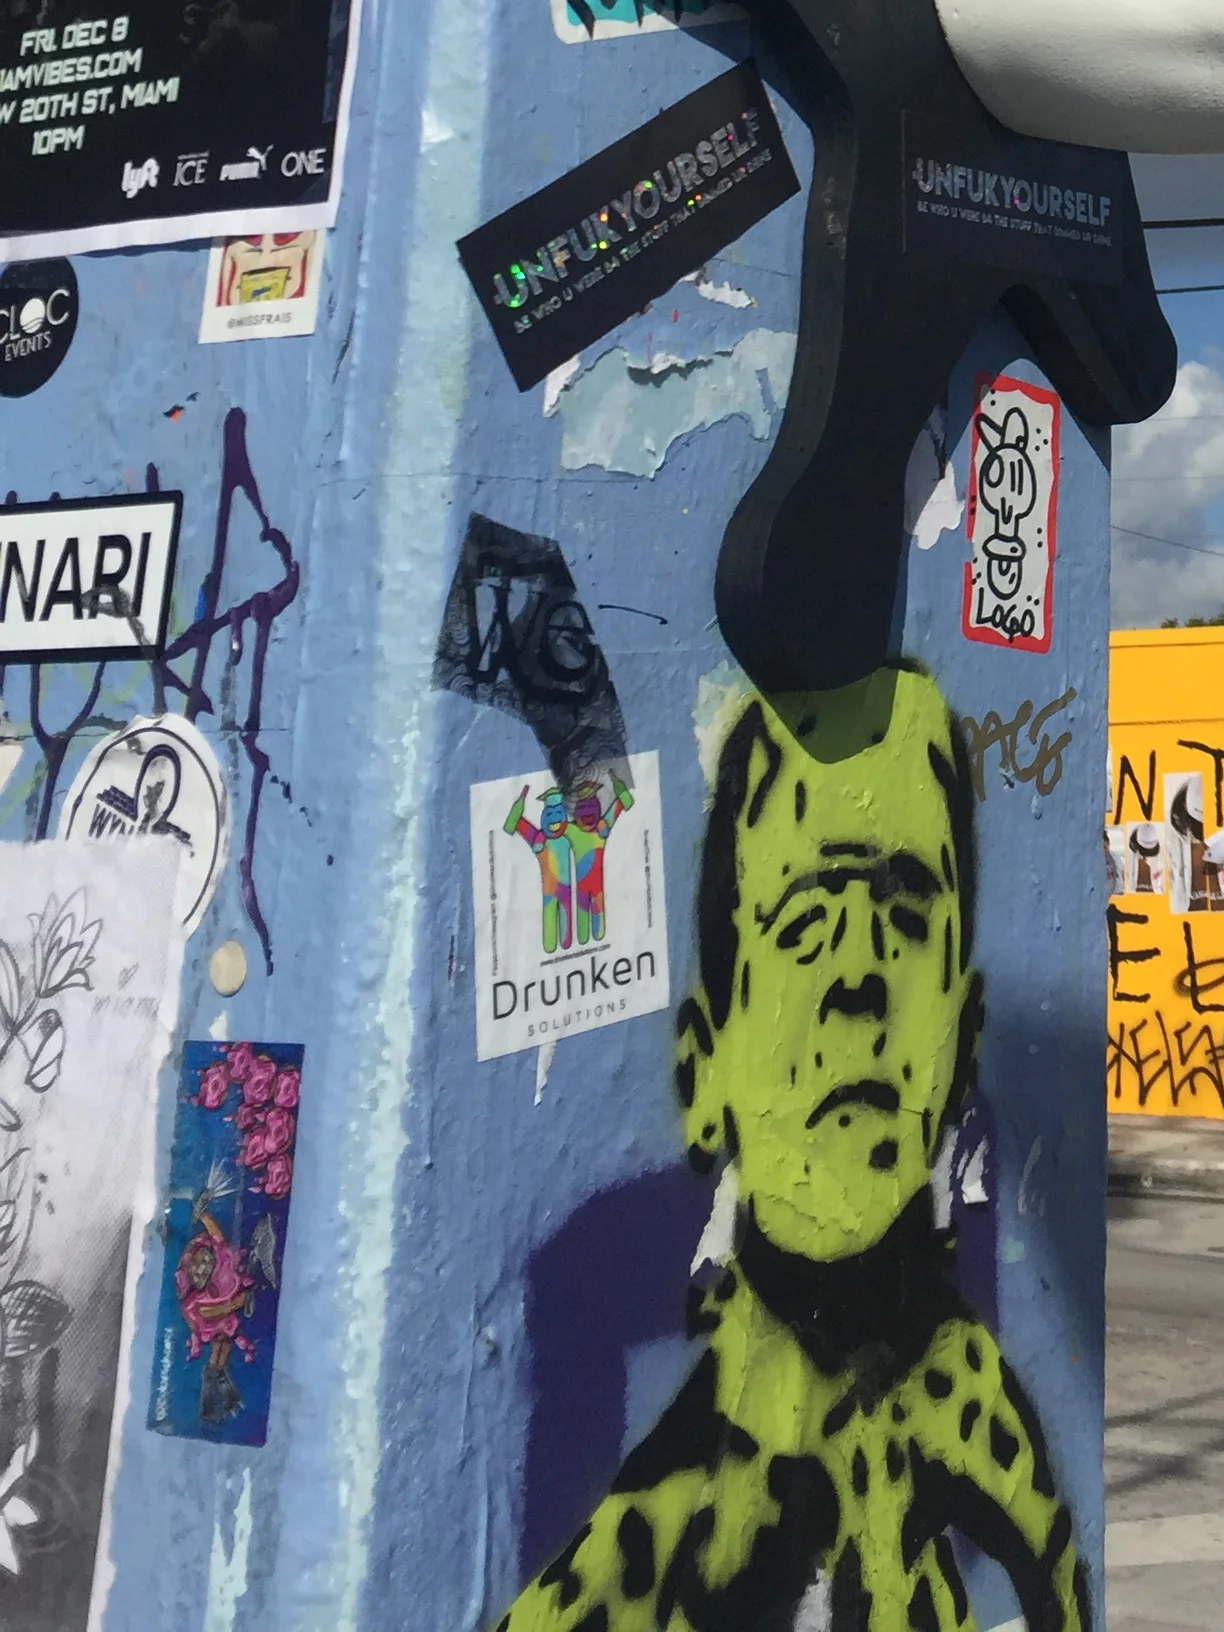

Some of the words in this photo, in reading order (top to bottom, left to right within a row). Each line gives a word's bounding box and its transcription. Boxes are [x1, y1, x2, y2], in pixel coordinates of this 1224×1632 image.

[62, 19, 108, 49] DEC
[111, 16, 129, 42] 8
[19, 92, 79, 124] 20TH
[120, 76, 180, 108] MIAMI
[32, 125, 85, 155] 10PM
[173, 158, 209, 186] ICE
[281, 148, 327, 177] ONE
[912, 157, 1111, 226] UNFUKYOURSELF
[5, 331, 51, 361] EVENTS
[0, 532, 152, 623] NARI
[492, 951, 655, 1020] Drunken
[527, 998, 627, 1037] SOLUTIONS
